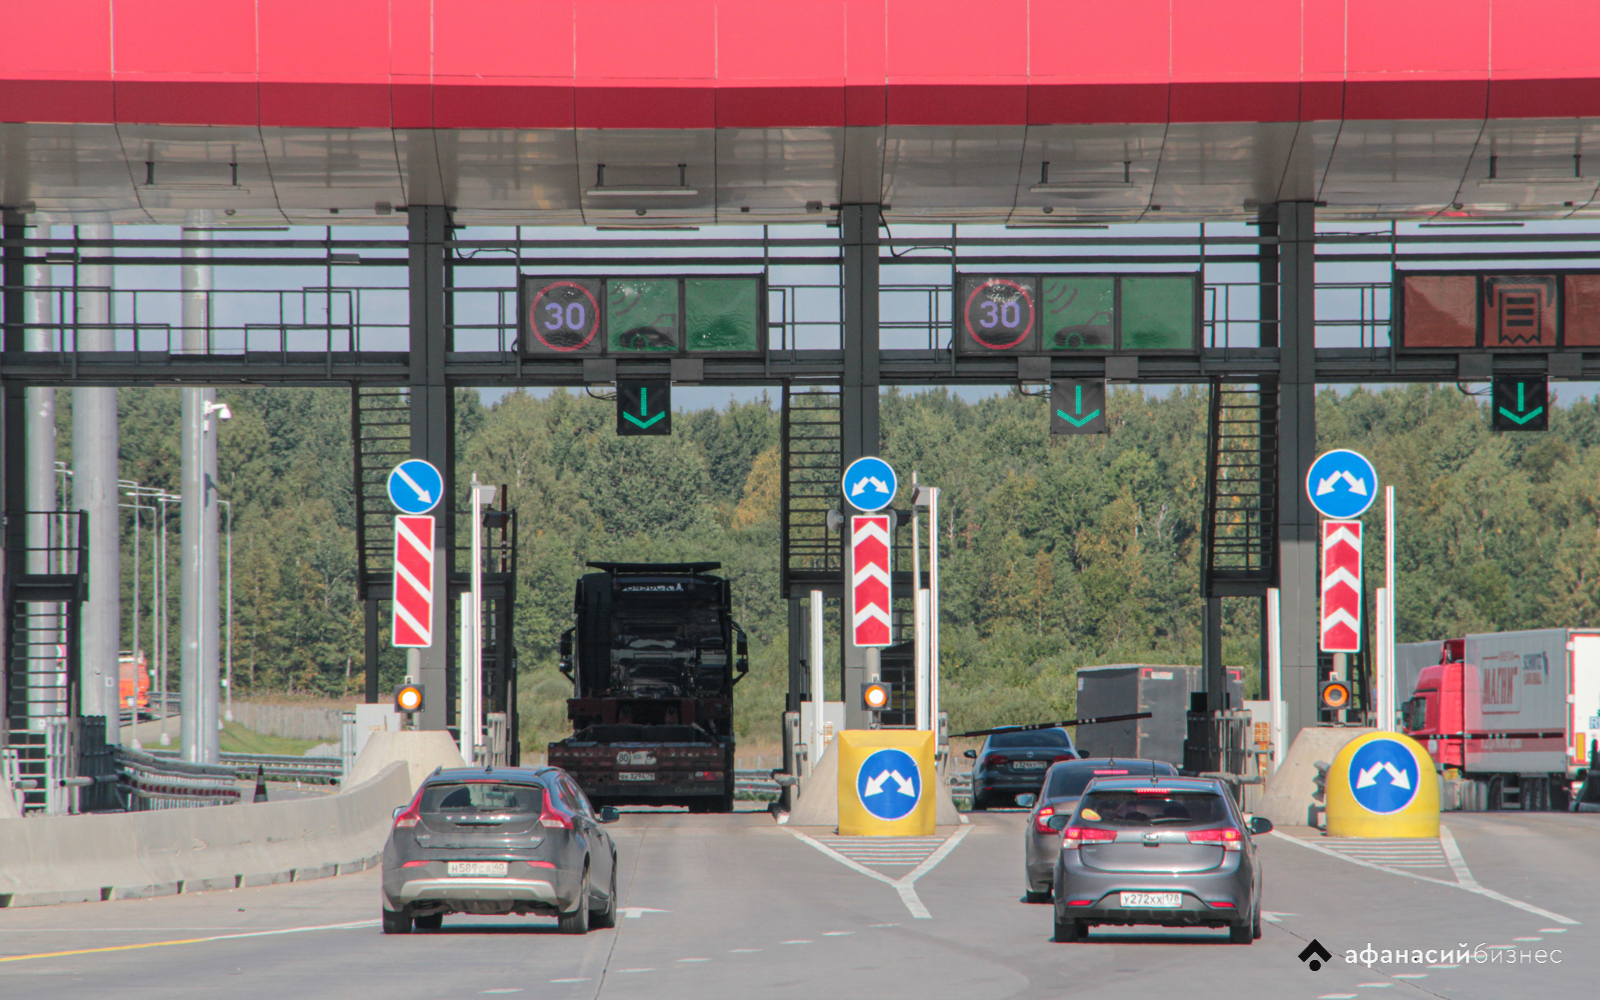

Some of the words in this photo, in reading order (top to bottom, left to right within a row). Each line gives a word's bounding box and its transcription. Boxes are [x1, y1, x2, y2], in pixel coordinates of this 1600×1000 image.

[544, 302, 586, 330] 30
[979, 301, 1021, 329] 30
[619, 753, 629, 762] 80
